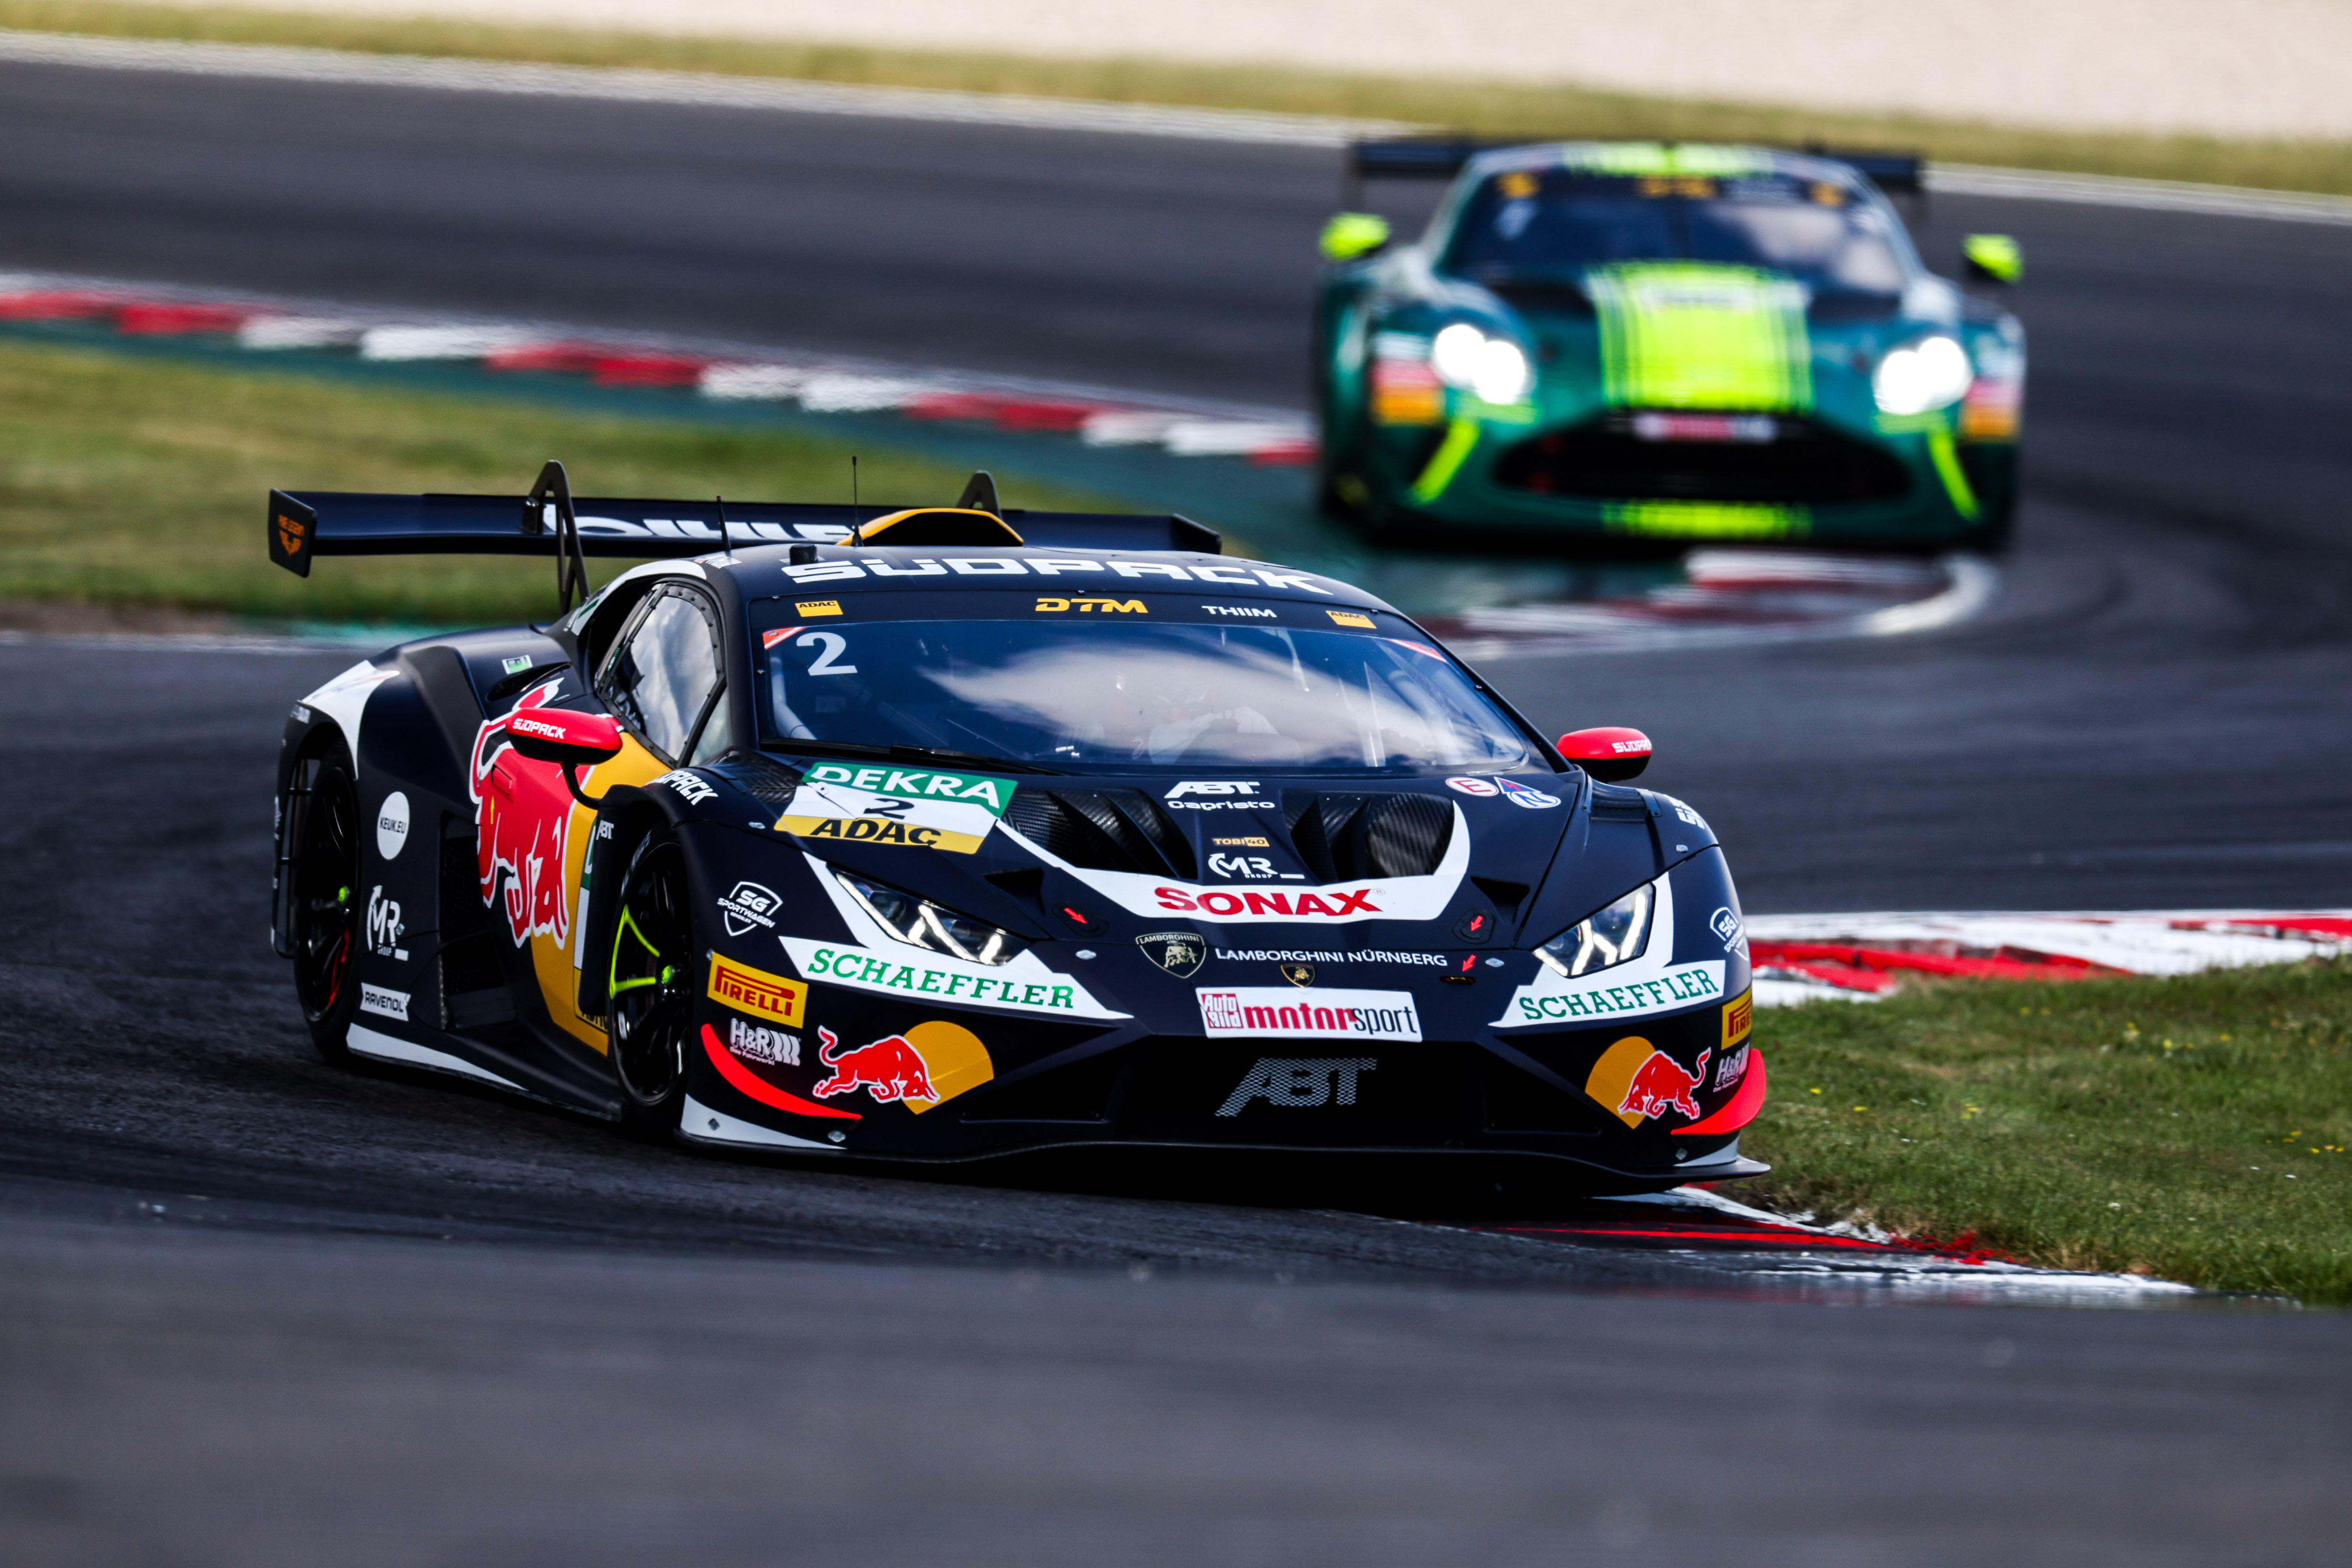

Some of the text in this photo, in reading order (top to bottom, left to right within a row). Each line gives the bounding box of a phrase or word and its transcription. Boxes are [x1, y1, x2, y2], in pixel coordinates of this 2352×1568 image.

[779, 559, 1333, 595] SÜDPACK
[1035, 598, 1149, 613] DTM
[1202, 605, 1278, 618] THIIM
[796, 631, 858, 676] 2
[811, 766, 1000, 809] DEKRA
[1164, 781, 1260, 799] ABT
[863, 798, 914, 819] 2
[1168, 801, 1275, 811] Capristo
[596, 820, 614, 840] ABT
[810, 819, 942, 846] ADAC
[717, 897, 776, 928] SPORTWAGEN
[736, 890, 771, 912] SG
[1155, 887, 1384, 916] SONAX
[1718, 914, 1737, 938] SG
[1139, 934, 1200, 944] LAMBORGHINI
[1215, 948, 1448, 966] LAMBORGHINI NÜRNBERG
[808, 949, 1074, 1008] SCHAEFFLER
[365, 991, 404, 1013] RAVENOL
[714, 965, 796, 1017] PIRELLI
[1519, 969, 1718, 1020] SCHAEFFLER
[1205, 995, 1237, 1011] Auto
[1207, 1011, 1243, 1027] Bild
[1728, 997, 1751, 1038] PIRE
[1214, 1058, 1377, 1117] ABT
